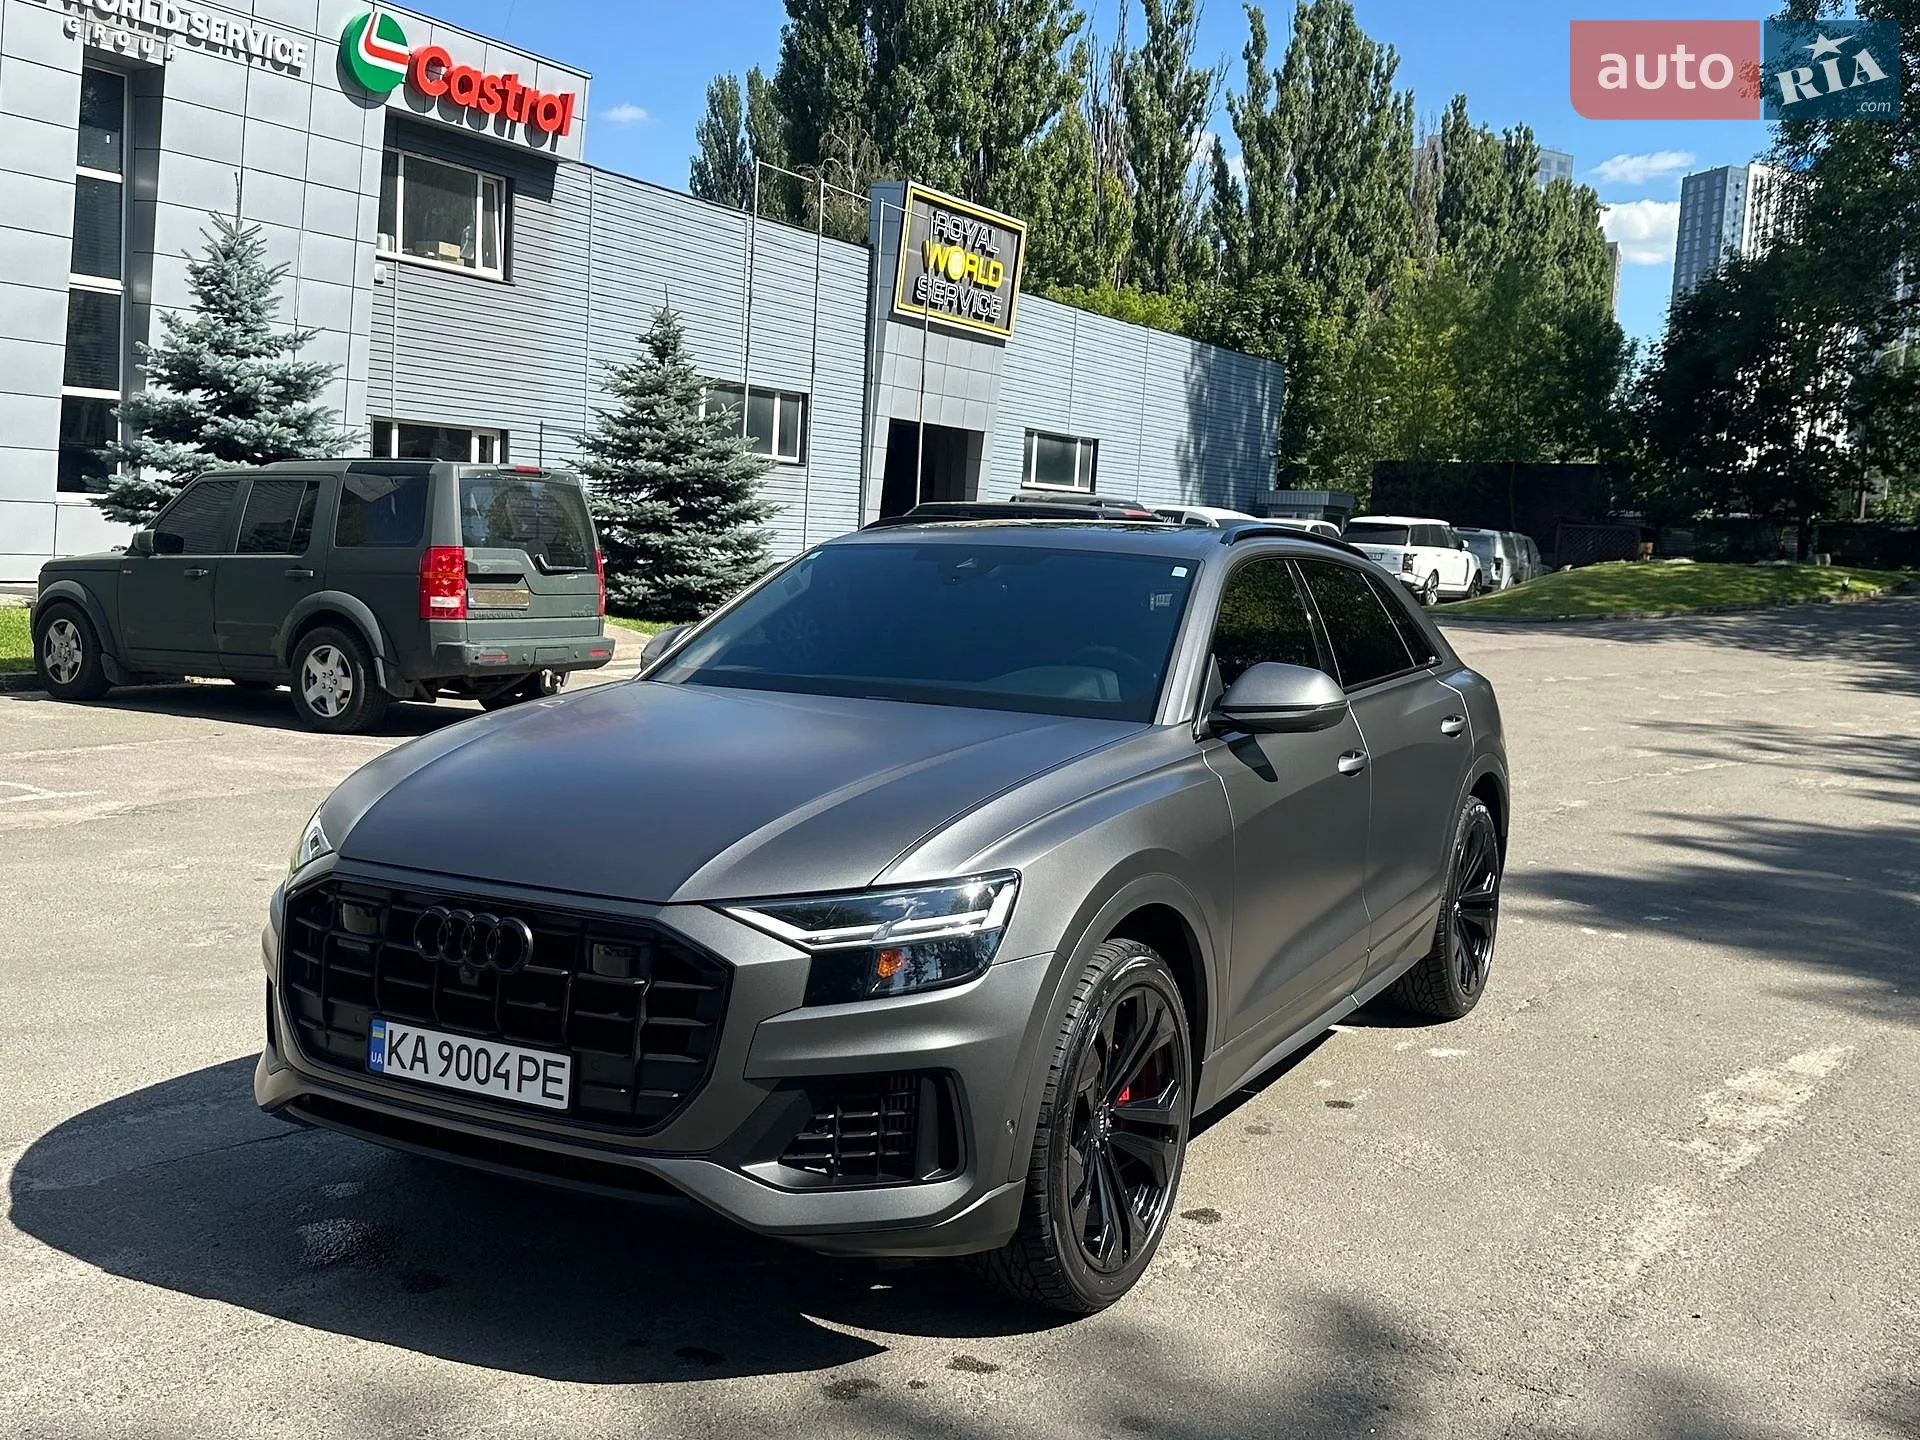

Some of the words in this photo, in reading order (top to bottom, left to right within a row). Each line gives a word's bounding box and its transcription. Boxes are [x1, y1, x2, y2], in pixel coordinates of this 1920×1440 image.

[66, 0, 182, 30] RLD
[188, 11, 308, 69] SERVICE
[66, 18, 177, 60] GROUP
[408, 45, 576, 137] Castrol
[932, 210, 1000, 255] ROYAL
[922, 239, 1004, 290] WORLD
[915, 274, 1003, 320] SERVICE
[370, 1052, 384, 1066] UA
[386, 1029, 430, 1076] KA
[437, 1040, 512, 1091] 9004
[516, 1054, 567, 1102] PE
